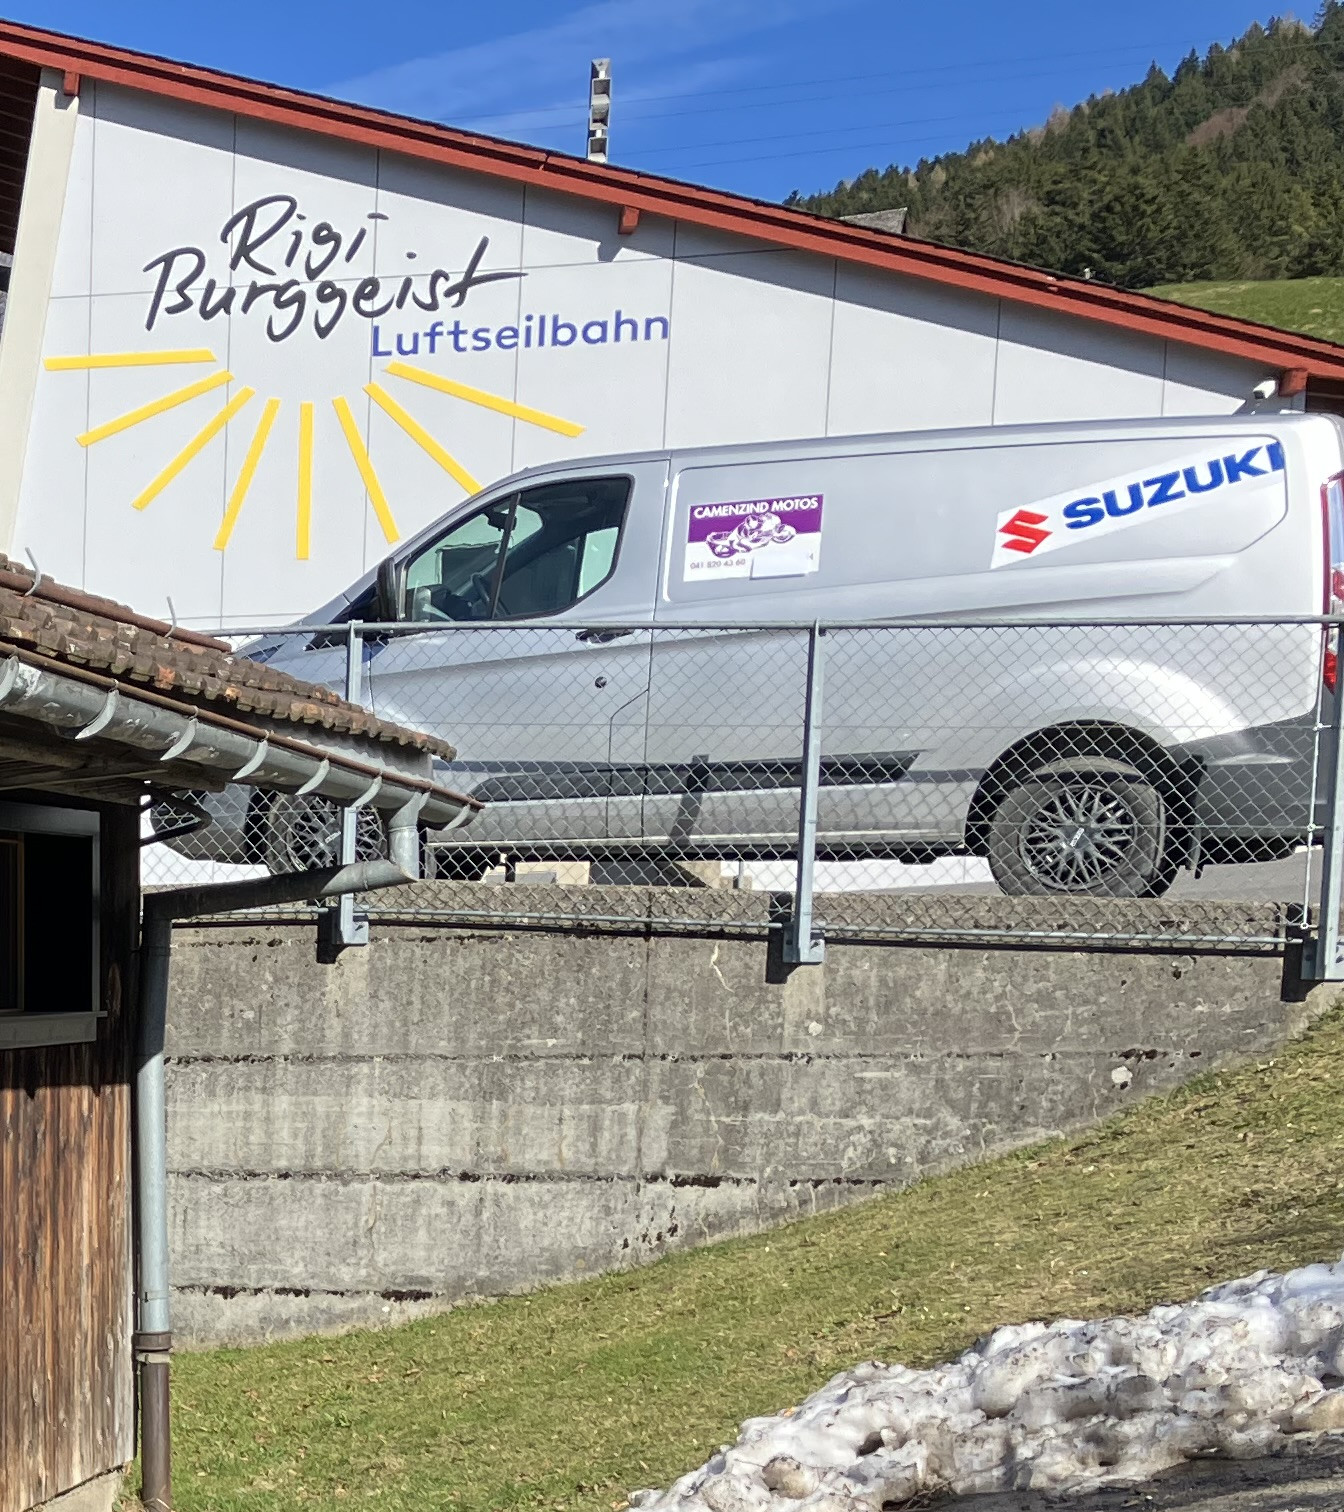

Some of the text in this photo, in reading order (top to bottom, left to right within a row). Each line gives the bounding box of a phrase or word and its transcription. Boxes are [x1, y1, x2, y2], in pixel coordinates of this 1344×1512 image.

[220, 194, 389, 281] Rigi
[142, 235, 529, 343] Burggeist
[371, 309, 669, 357] Luftseilbahn
[693, 497, 819, 519] CAMENZIND MOTOS
[1062, 440, 1286, 530] SUZUKI
